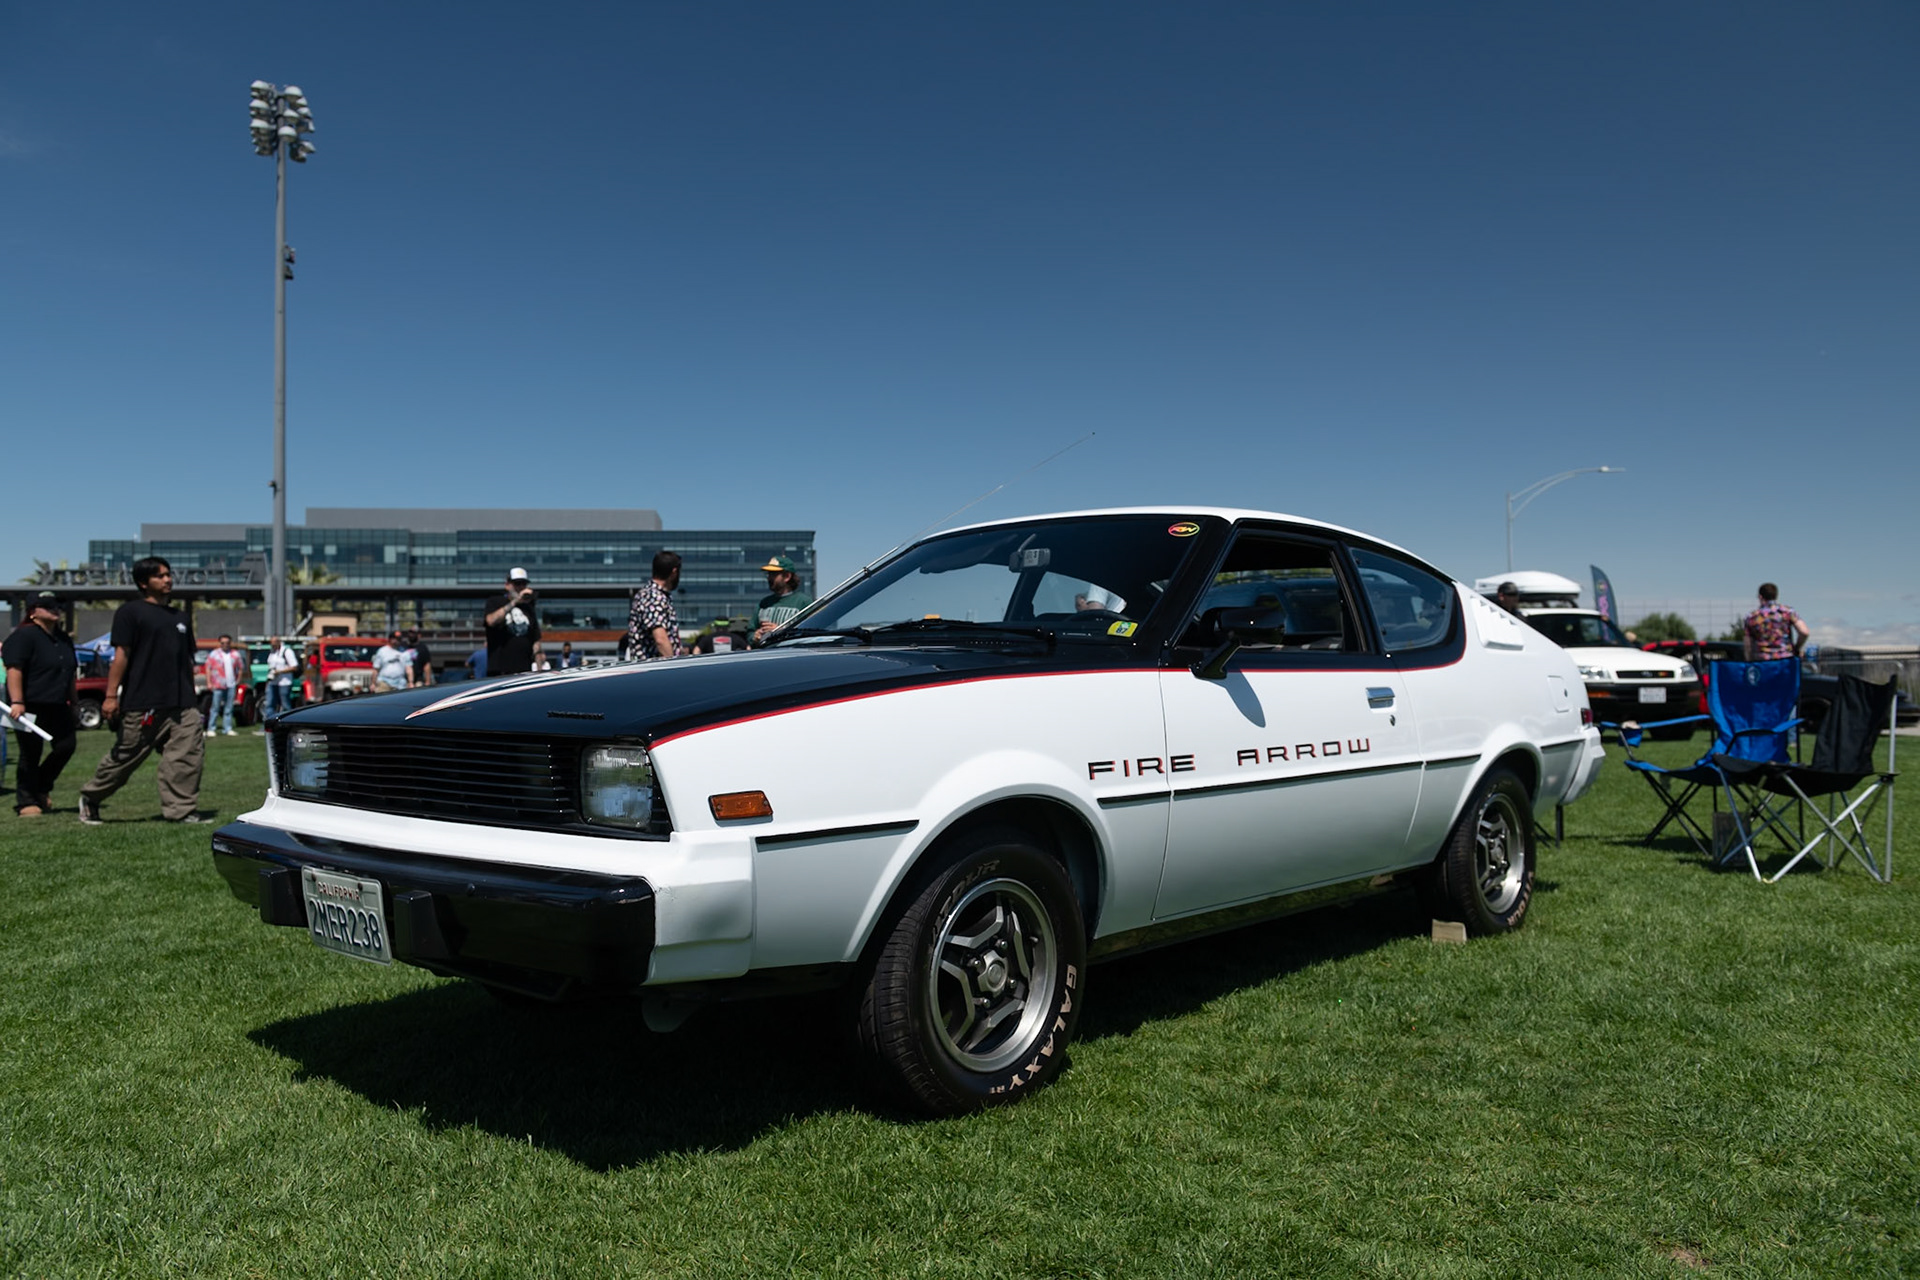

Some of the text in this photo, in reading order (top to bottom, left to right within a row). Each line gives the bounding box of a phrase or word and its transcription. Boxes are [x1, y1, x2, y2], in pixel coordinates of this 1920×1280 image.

[1088, 738, 1371, 780] FIRE ARROW
[317, 881, 361, 901] CALIFORNIA
[310, 899, 383, 951] 2NER238
[1009, 964, 1077, 1091] GALAXY
